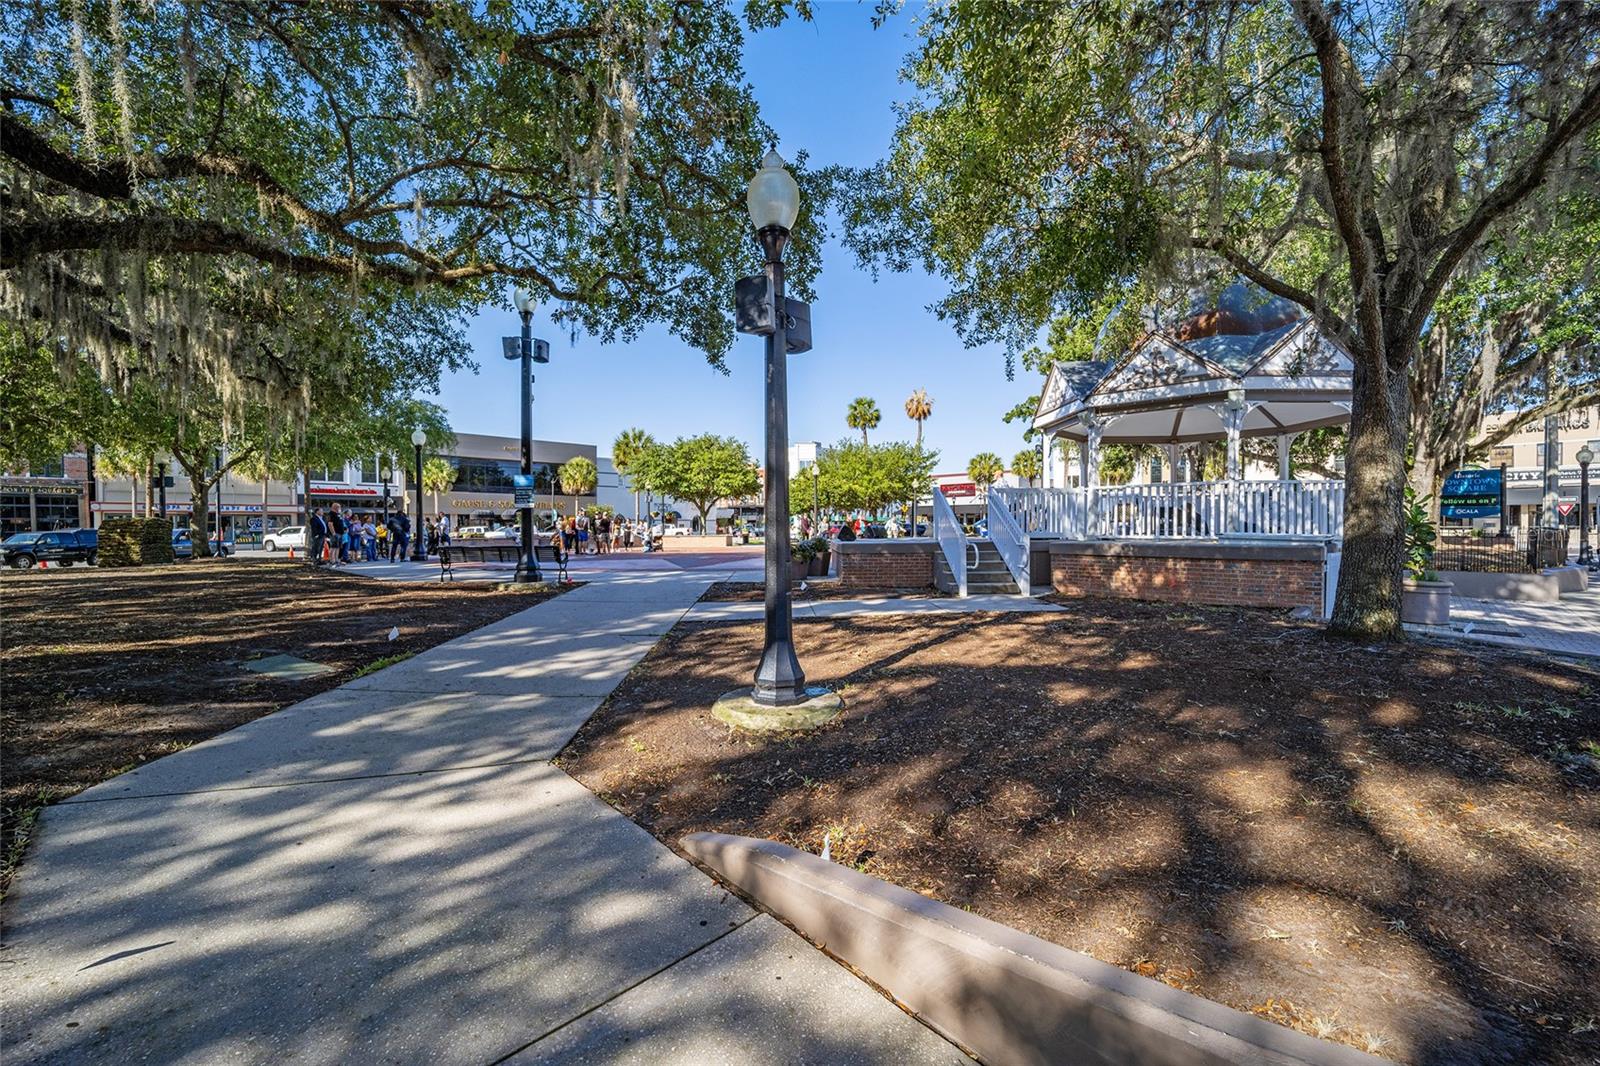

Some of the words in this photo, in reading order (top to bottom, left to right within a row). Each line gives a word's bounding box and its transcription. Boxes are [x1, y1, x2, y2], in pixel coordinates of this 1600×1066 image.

[1506, 472, 1541, 480] CITY
[1445, 478, 1497, 486] OWNTOWN
[1447, 485, 1487, 493] SQUARE
